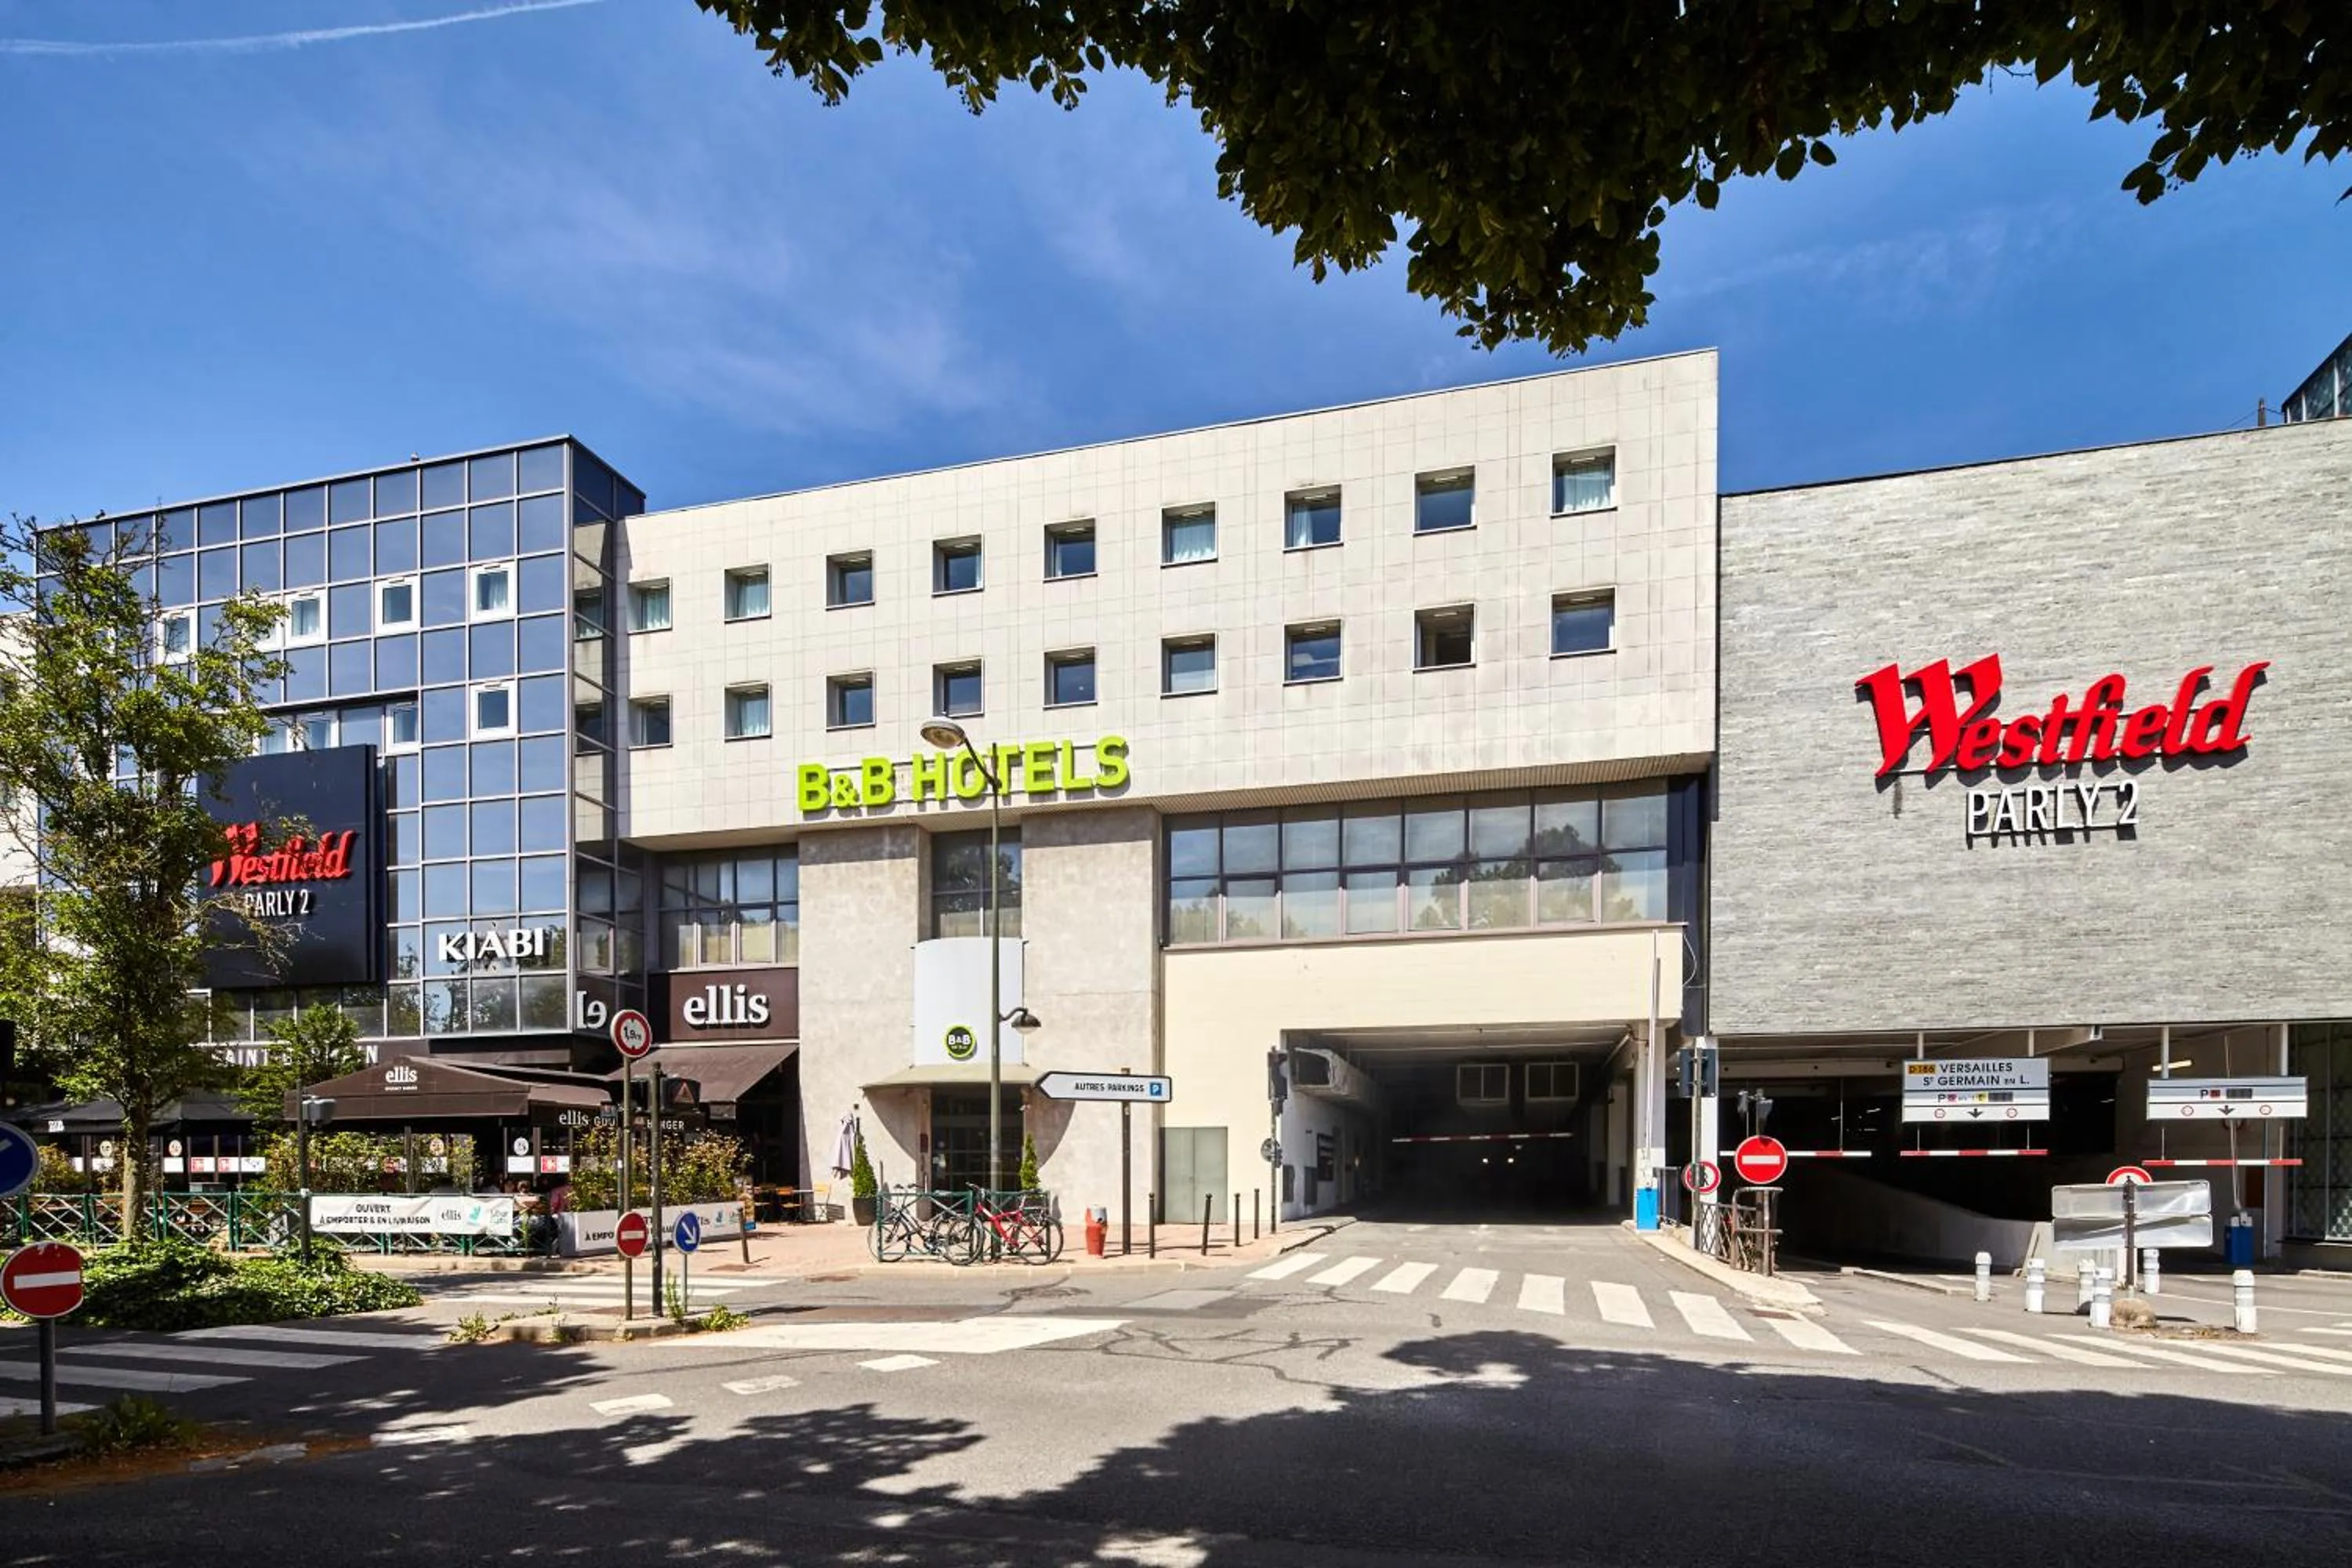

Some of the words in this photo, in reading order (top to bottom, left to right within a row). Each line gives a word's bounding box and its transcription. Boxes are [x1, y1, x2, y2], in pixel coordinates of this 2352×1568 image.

[1856, 653, 2270, 776] Westfield
[798, 757, 895, 811] B&B
[912, 735, 1128, 803] HOTELS
[1967, 782, 2103, 834] PARLY
[2118, 780, 2139, 826] 2
[299, 888, 310, 914] 2
[438, 927, 544, 961] KIABI
[683, 984, 769, 1025] ellis
[385, 1065, 418, 1083] ellis
[1940, 1062, 2013, 1073] VERSAILLES
[1075, 1082, 1105, 1091] AUTRES
[1108, 1083, 1145, 1092] PARKINGS
[1938, 1075, 1999, 1087] GERMAIN
[2201, 1089, 2209, 1099] P
[559, 1109, 589, 1125] ellis
[356, 1204, 391, 1213] OUVERT
